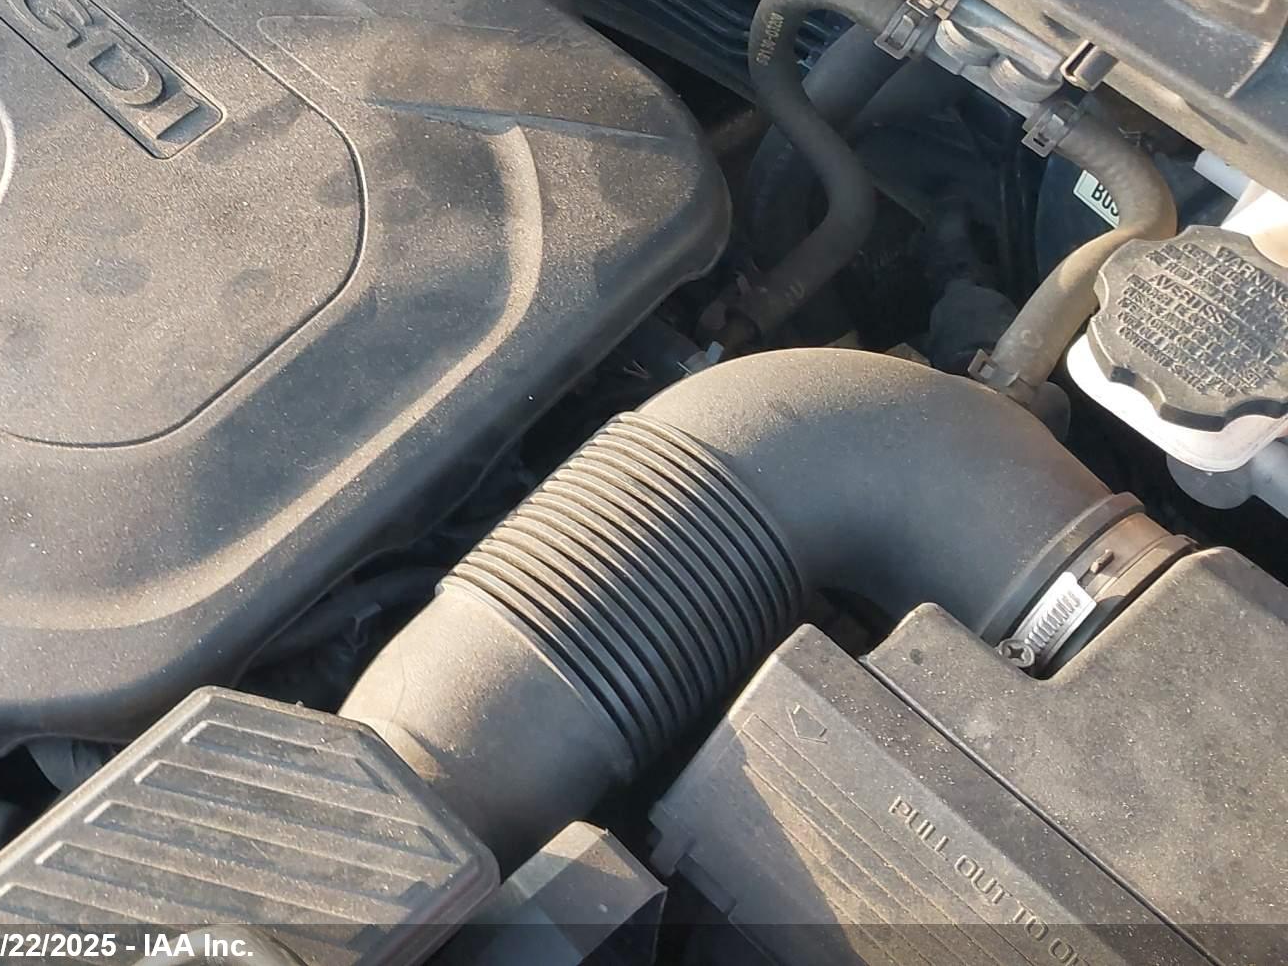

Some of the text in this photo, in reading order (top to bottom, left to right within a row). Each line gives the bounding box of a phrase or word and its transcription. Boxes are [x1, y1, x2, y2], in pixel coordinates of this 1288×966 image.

[888, 795, 1050, 942] PULL OUT TO
